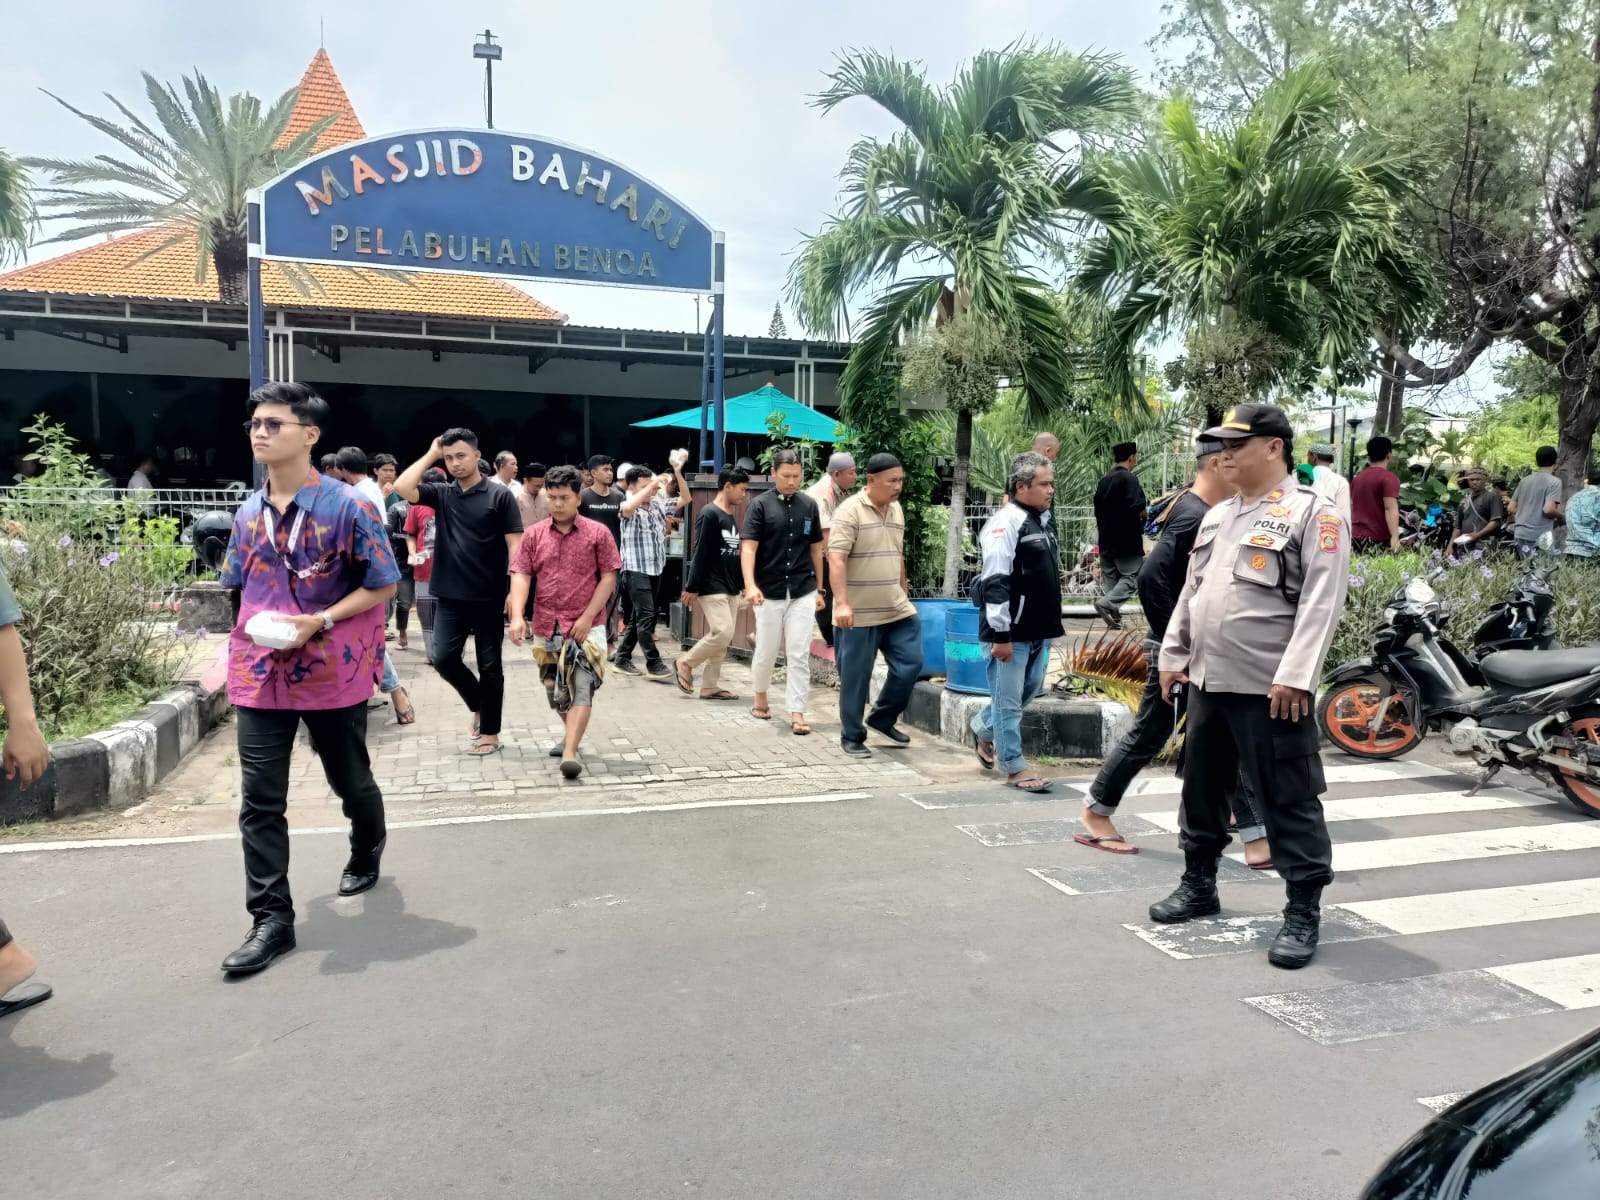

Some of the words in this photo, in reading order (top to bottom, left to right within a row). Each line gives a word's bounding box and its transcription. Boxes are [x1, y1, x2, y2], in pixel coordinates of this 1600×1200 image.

[294, 138, 483, 216] MASJID
[510, 144, 688, 250] BAHARI
[330, 223, 541, 268] PELABUHAN
[553, 243, 657, 278] BENOA
[1253, 519, 1291, 535] POLRI
